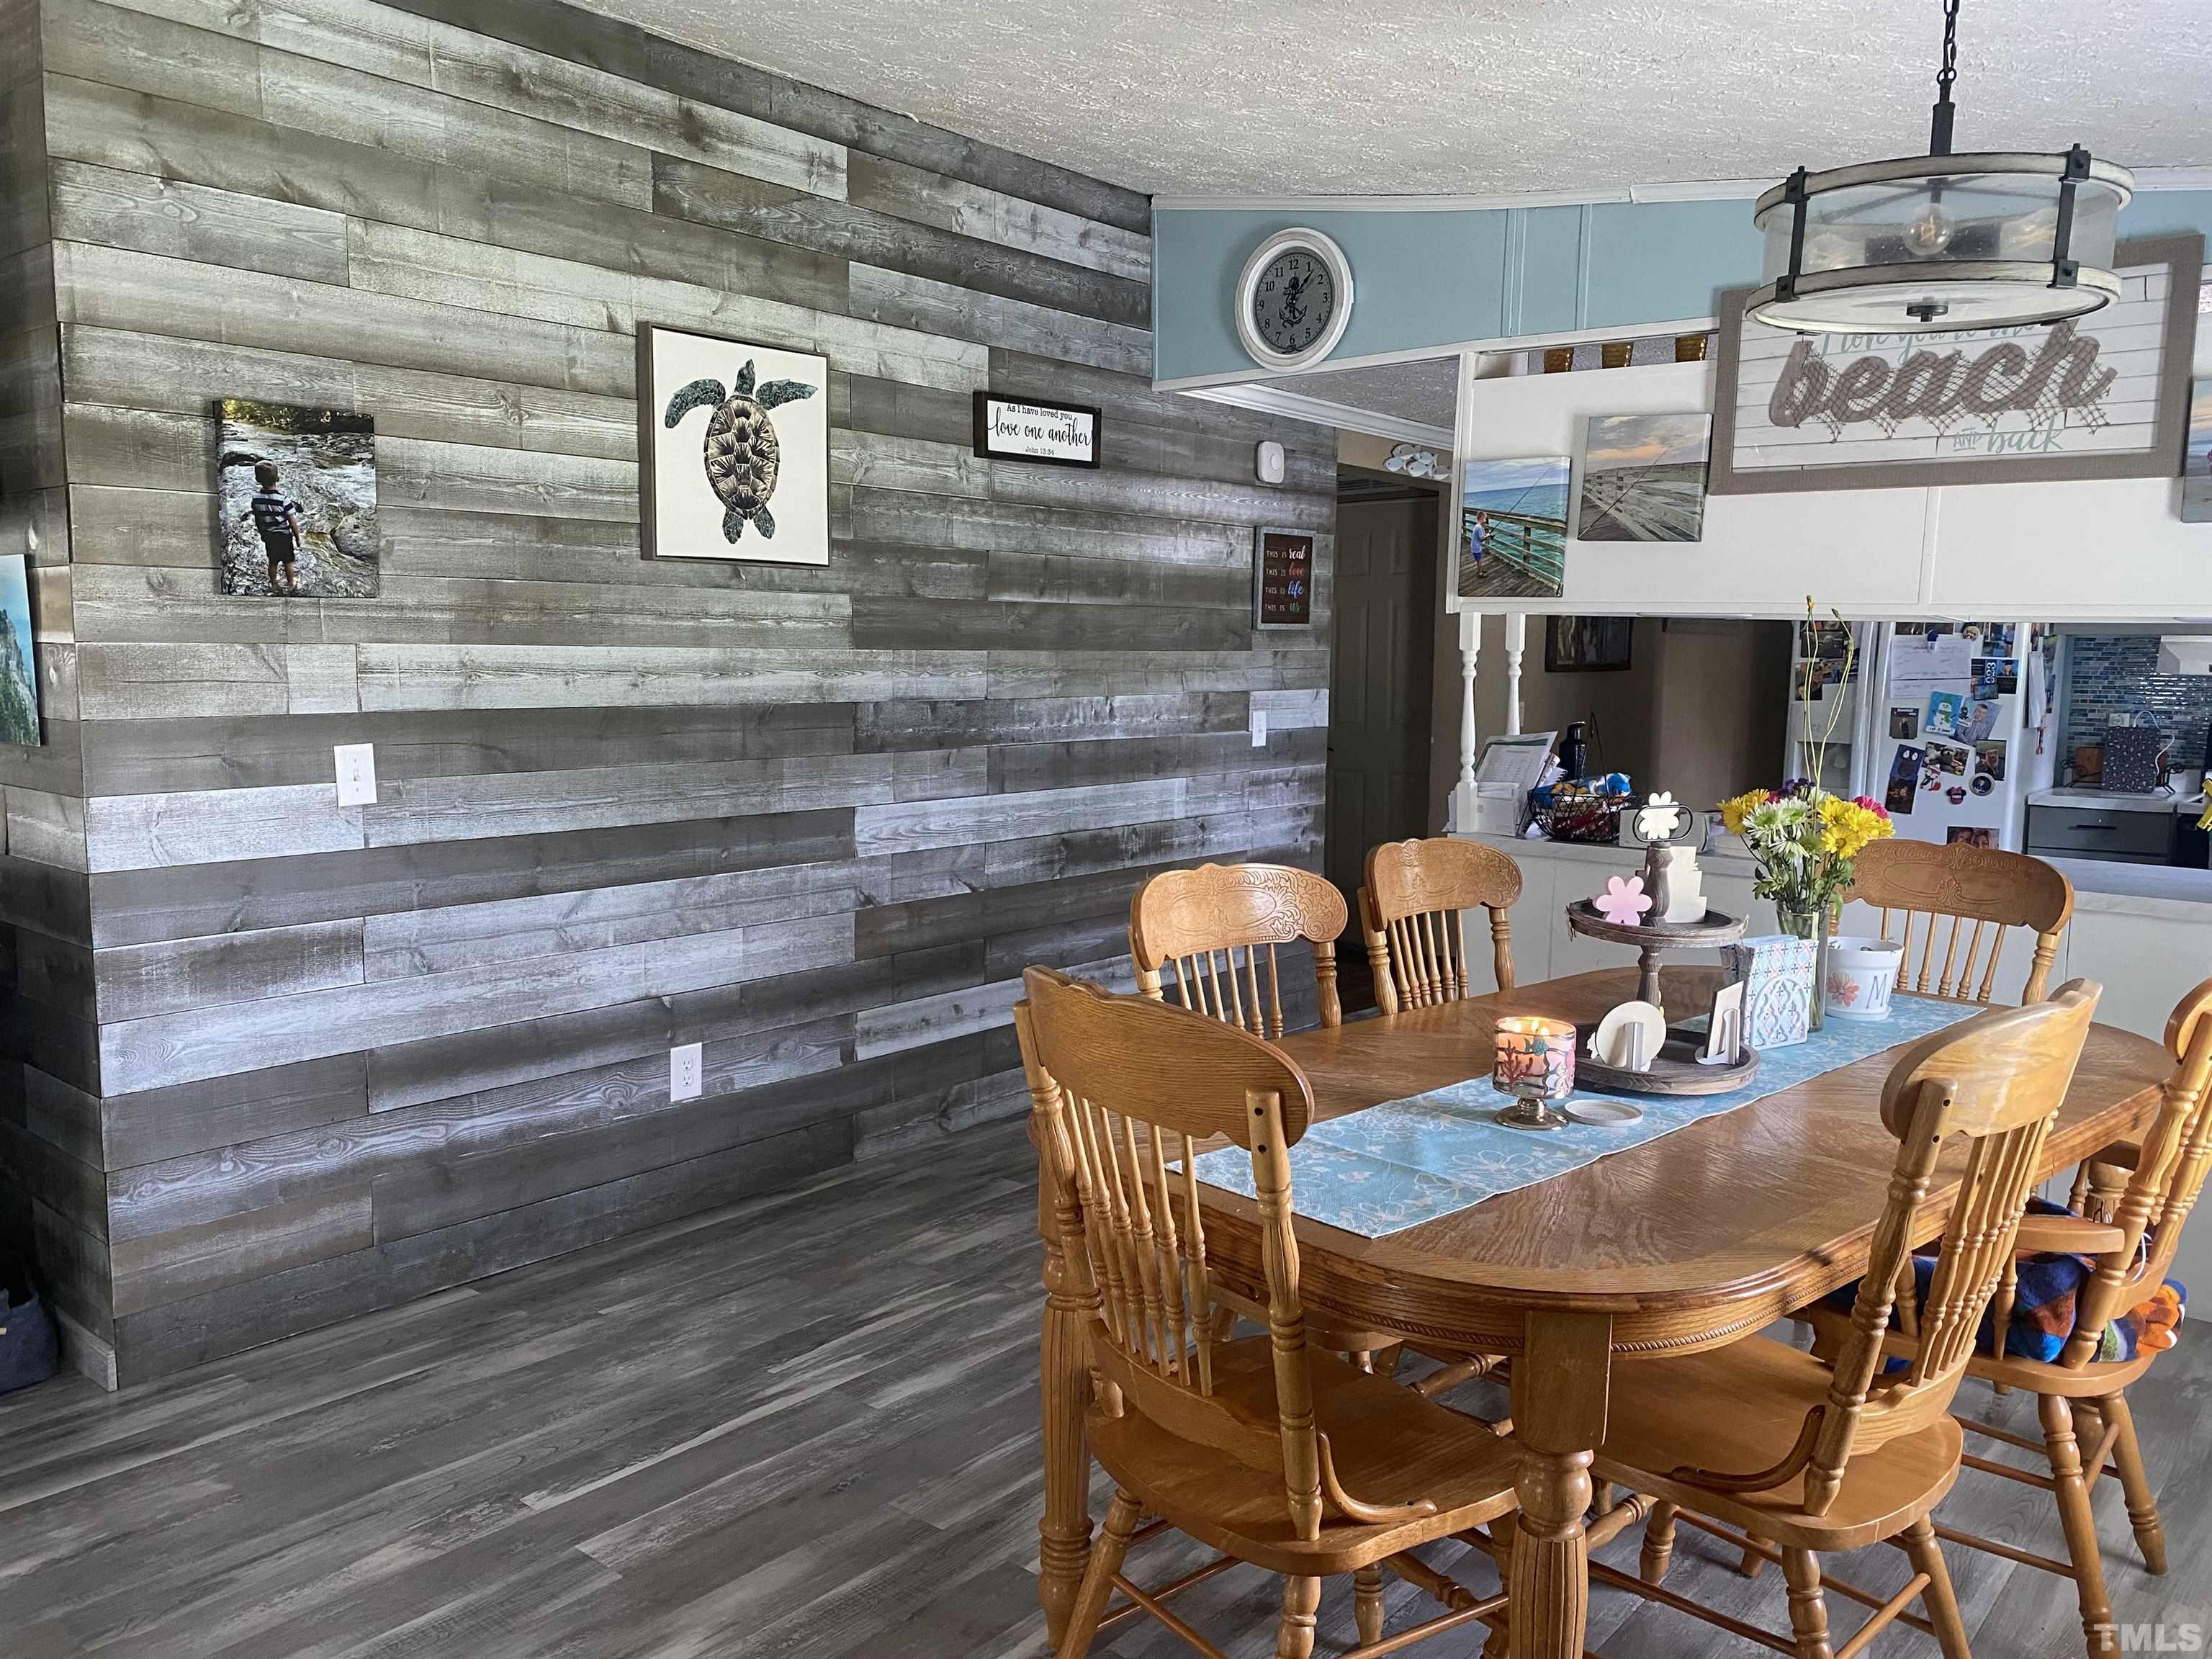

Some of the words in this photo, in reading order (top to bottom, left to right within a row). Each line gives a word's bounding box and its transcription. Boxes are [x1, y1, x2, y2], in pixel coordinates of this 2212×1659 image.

[1288, 259, 1299, 270] 12
[1307, 262, 1312, 271] 1
[1274, 267, 1284, 278] 11
[1318, 274, 1323, 284] 2
[1264, 281, 1274, 292] 10
[1322, 292, 1328, 303] 3
[1259, 300, 1264, 310] 9
[1264, 318, 1270, 328] 8
[1316, 313, 1323, 323] 4
[1275, 332, 1281, 341] 7
[1305, 328, 1310, 338] 5
[1290, 334, 1295, 344] 6
[1769, 319, 2118, 427] beach
[1007, 404, 1015, 413] As
[1022, 405, 1038, 415] have
[1040, 408, 1058, 418] loved
[988, 406, 1021, 437] love
[1025, 425, 1045, 440] one
[1048, 417, 1093, 446] another
[1952, 428, 1982, 451] AND
[1987, 414, 2063, 454] back
[1289, 545, 1306, 559] real
[1288, 580, 1305, 598] life
[1866, 974, 1887, 1010] M
